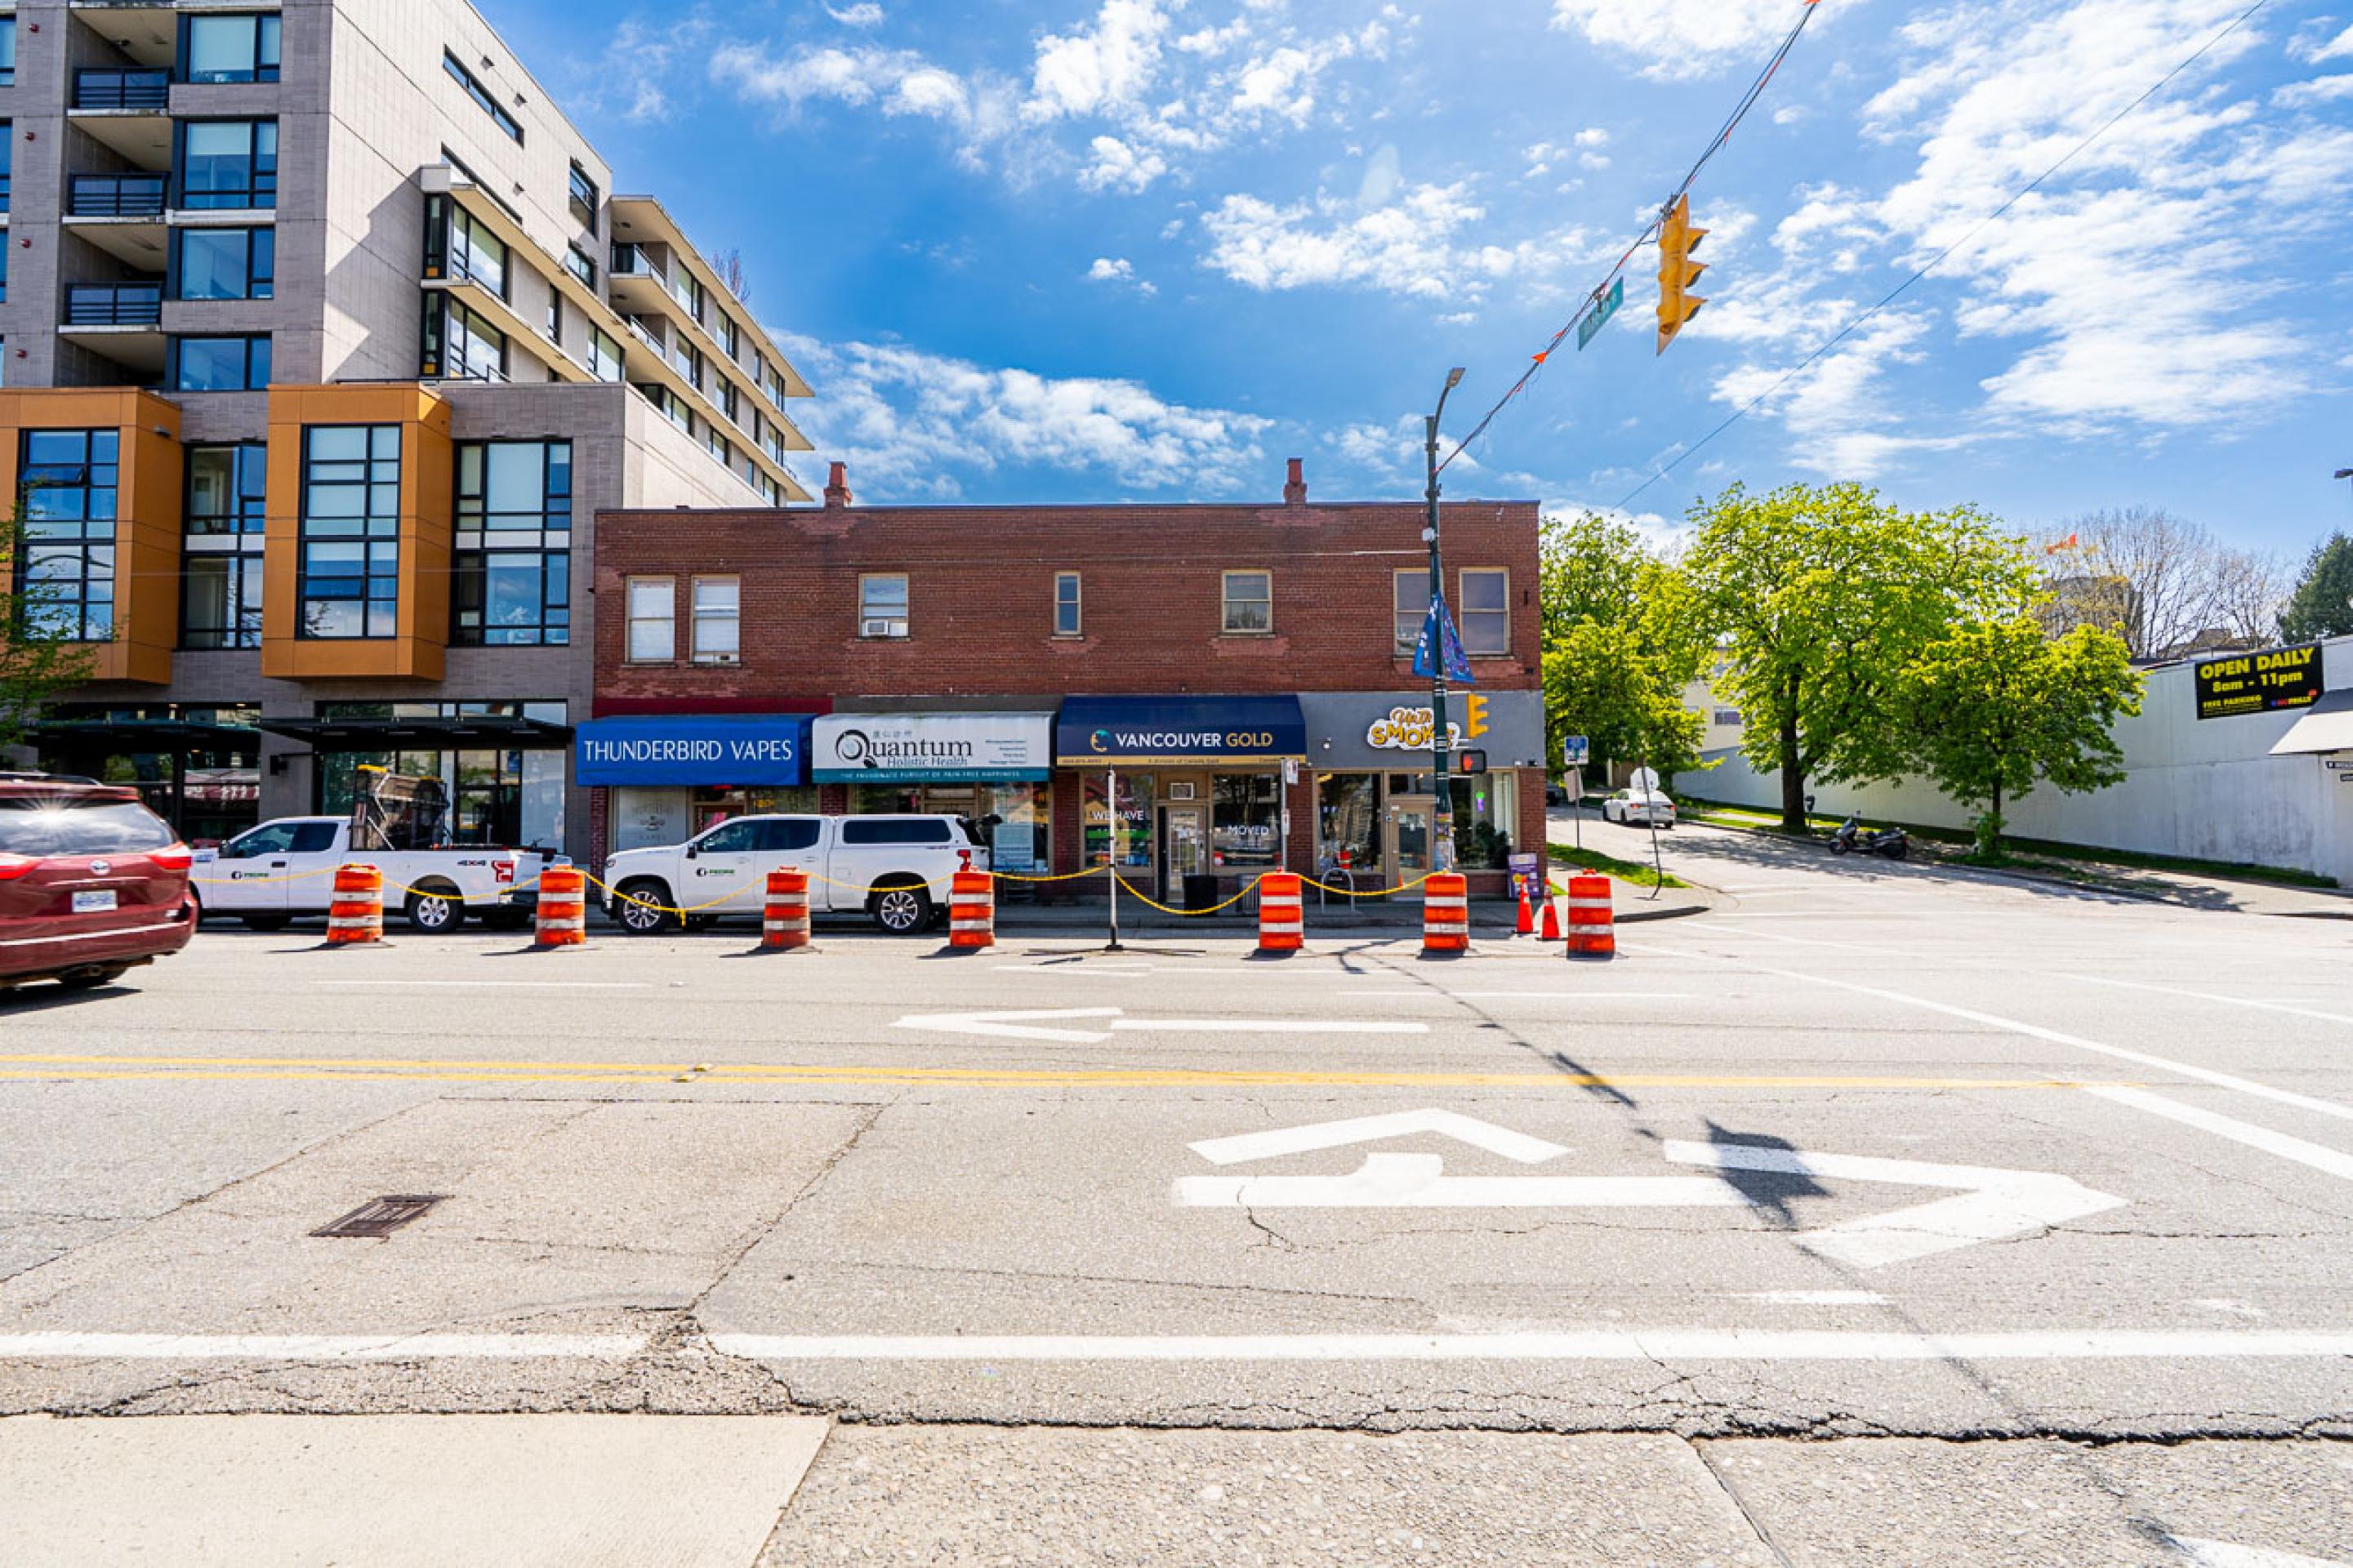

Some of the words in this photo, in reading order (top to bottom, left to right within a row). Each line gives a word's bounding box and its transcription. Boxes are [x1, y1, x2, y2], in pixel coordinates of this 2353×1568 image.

[2199, 657, 2250, 679] OPEN
[2256, 647, 2315, 670] DAILY
[2213, 680, 2244, 693] 8am
[2260, 671, 2303, 687] 11pm
[1115, 733, 1222, 748] VANCOUVER
[1225, 732, 1273, 748] GOLD
[1370, 724, 1455, 747] SMOK
[584, 739, 724, 762] THUNDERBIRD
[731, 739, 793, 761] VAPES
[835, 728, 974, 768] Quantum
[887, 756, 927, 768] Holistic
[931, 756, 968, 767] Health
[1228, 824, 1269, 836] MOVED
